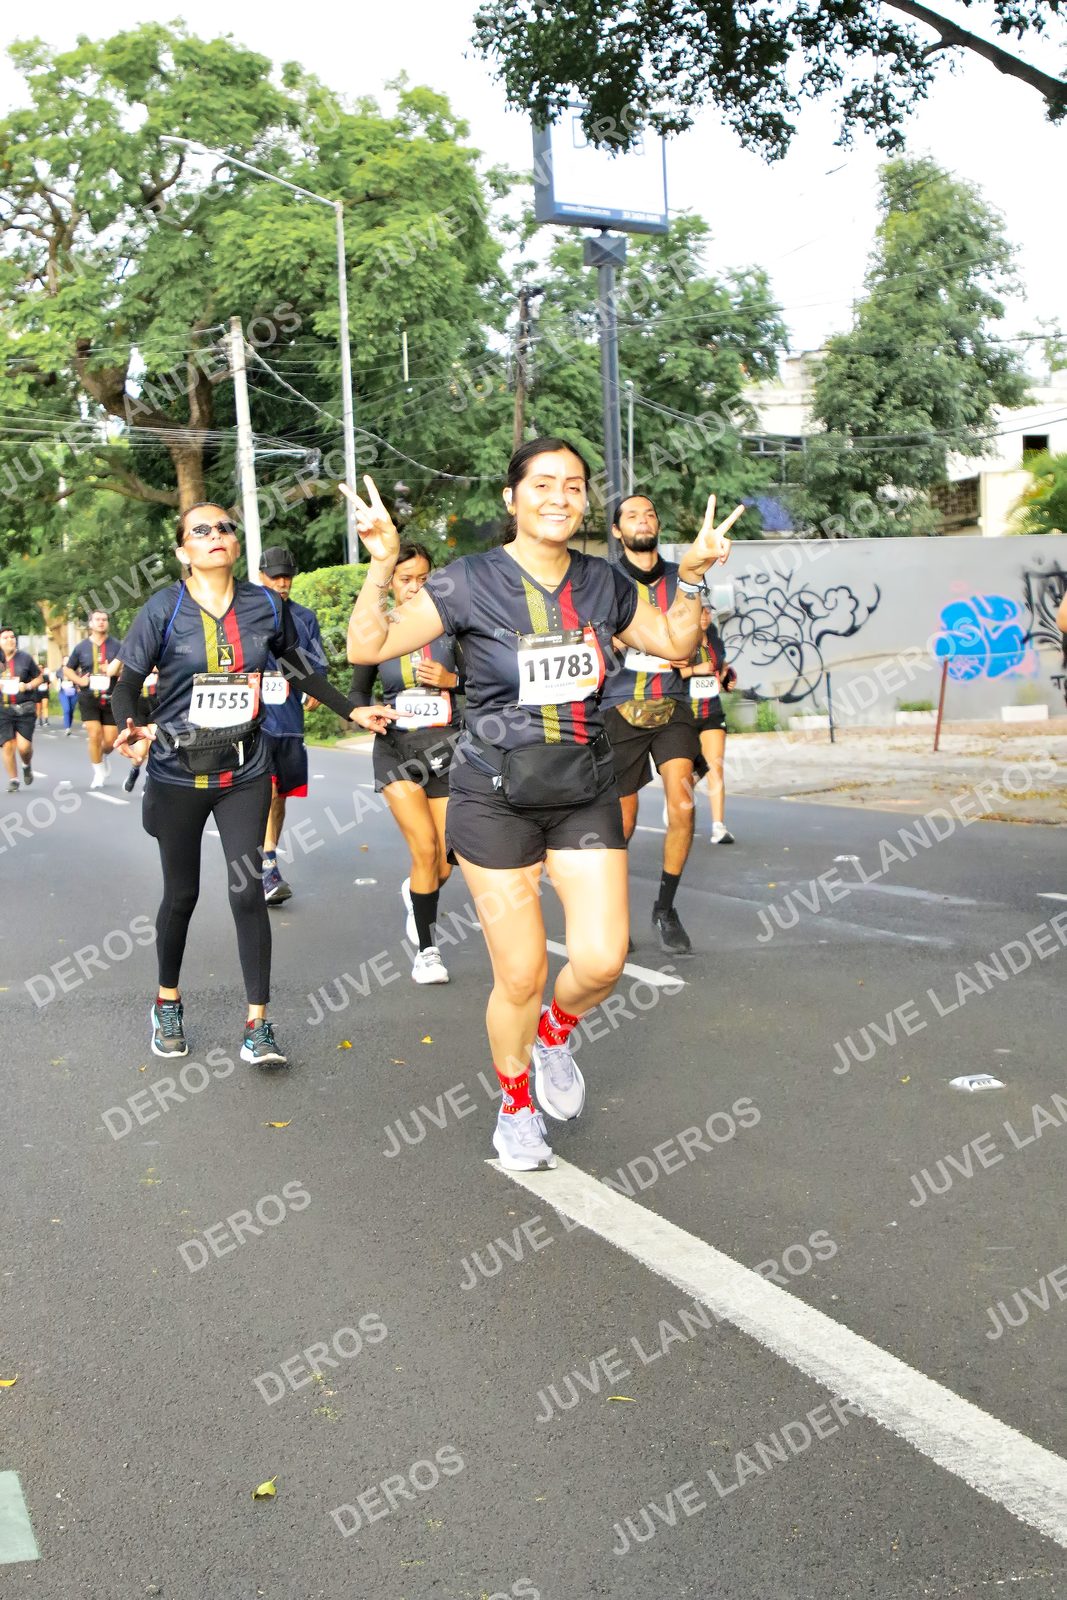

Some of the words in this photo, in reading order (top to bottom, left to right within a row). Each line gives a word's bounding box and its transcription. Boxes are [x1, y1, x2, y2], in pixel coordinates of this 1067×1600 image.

[736, 570, 793, 592] TOY
[524, 653, 593, 682] 11783
[196, 692, 248, 709] 11555
[404, 703, 439, 716] 9623
